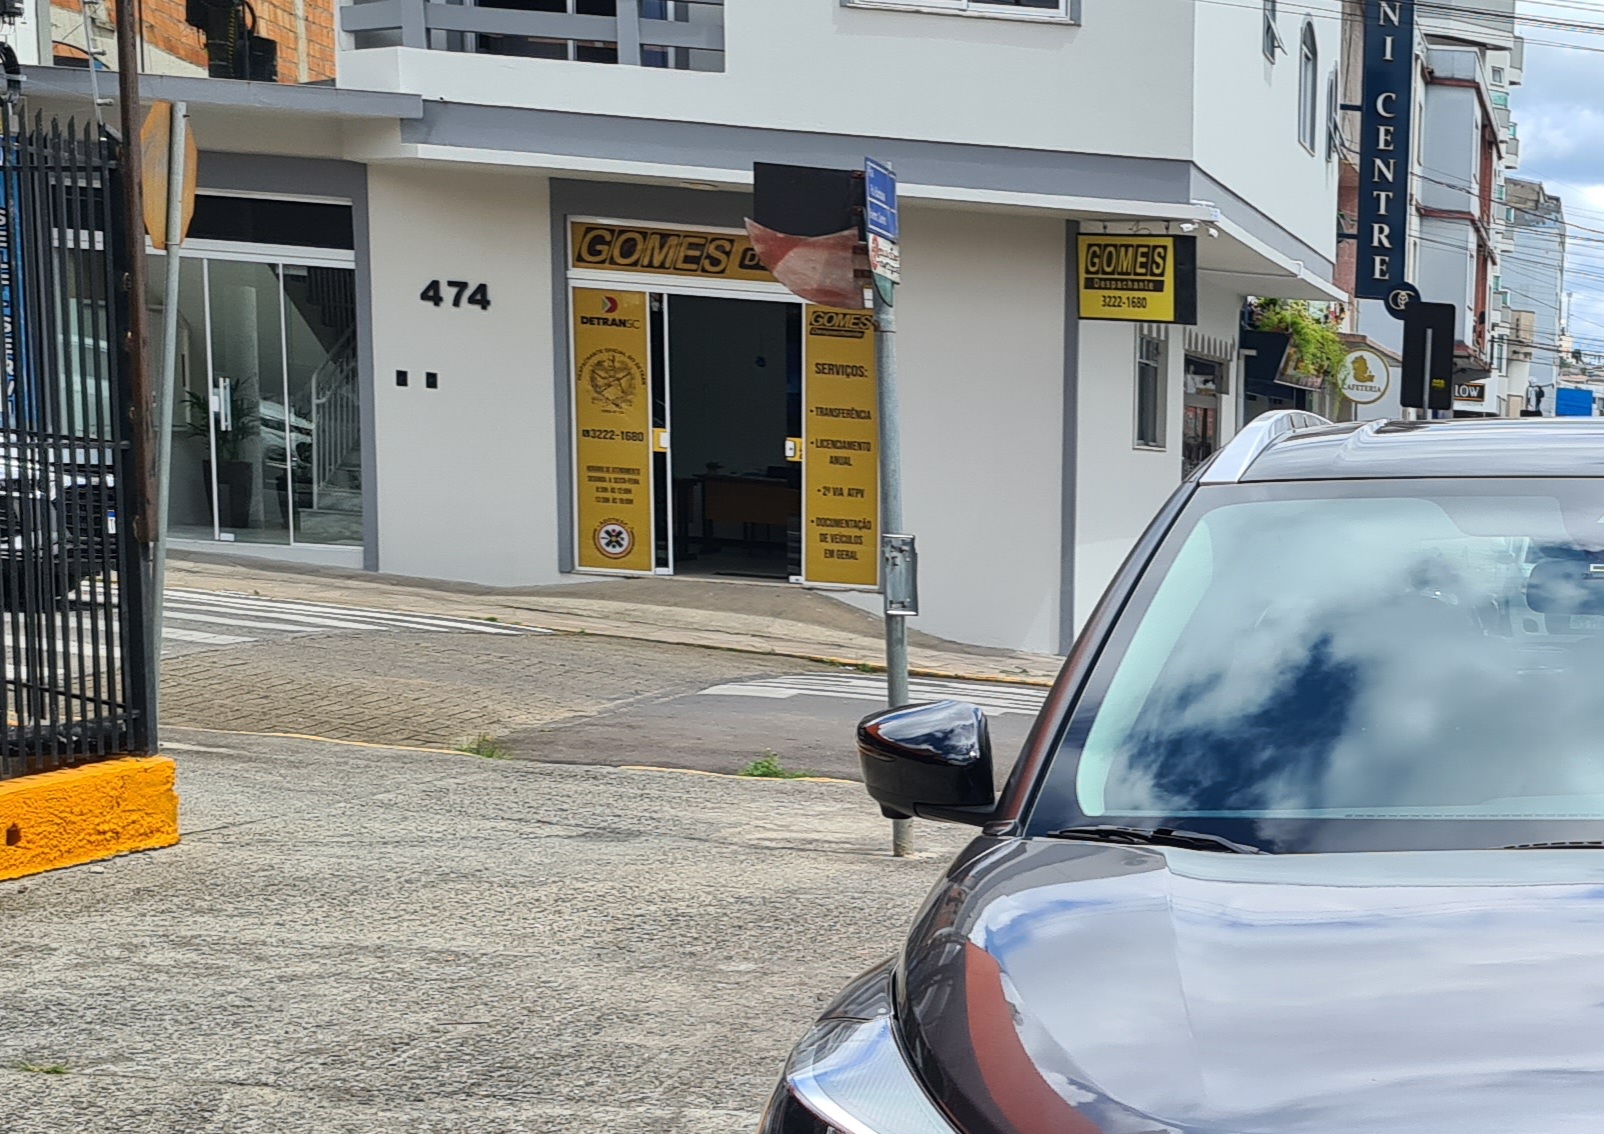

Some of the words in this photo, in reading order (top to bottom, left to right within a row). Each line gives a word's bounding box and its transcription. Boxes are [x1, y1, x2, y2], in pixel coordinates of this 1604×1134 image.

[1372, 92, 1396, 280] CENTRE
[580, 229, 734, 274] GOMES
[1087, 245, 1165, 274] GOMES
[1094, 279, 1154, 290] Despachante
[420, 280, 491, 310] 474
[1102, 295, 1148, 309] 3222-1680
[580, 315, 640, 329] DETRANSC
[811, 311, 873, 330] GOMES
[815, 362, 868, 378] SERVIÇOS:
[815, 406, 872, 420] TRANSFERÊNCIA
[590, 429, 644, 442] 3222-1680
